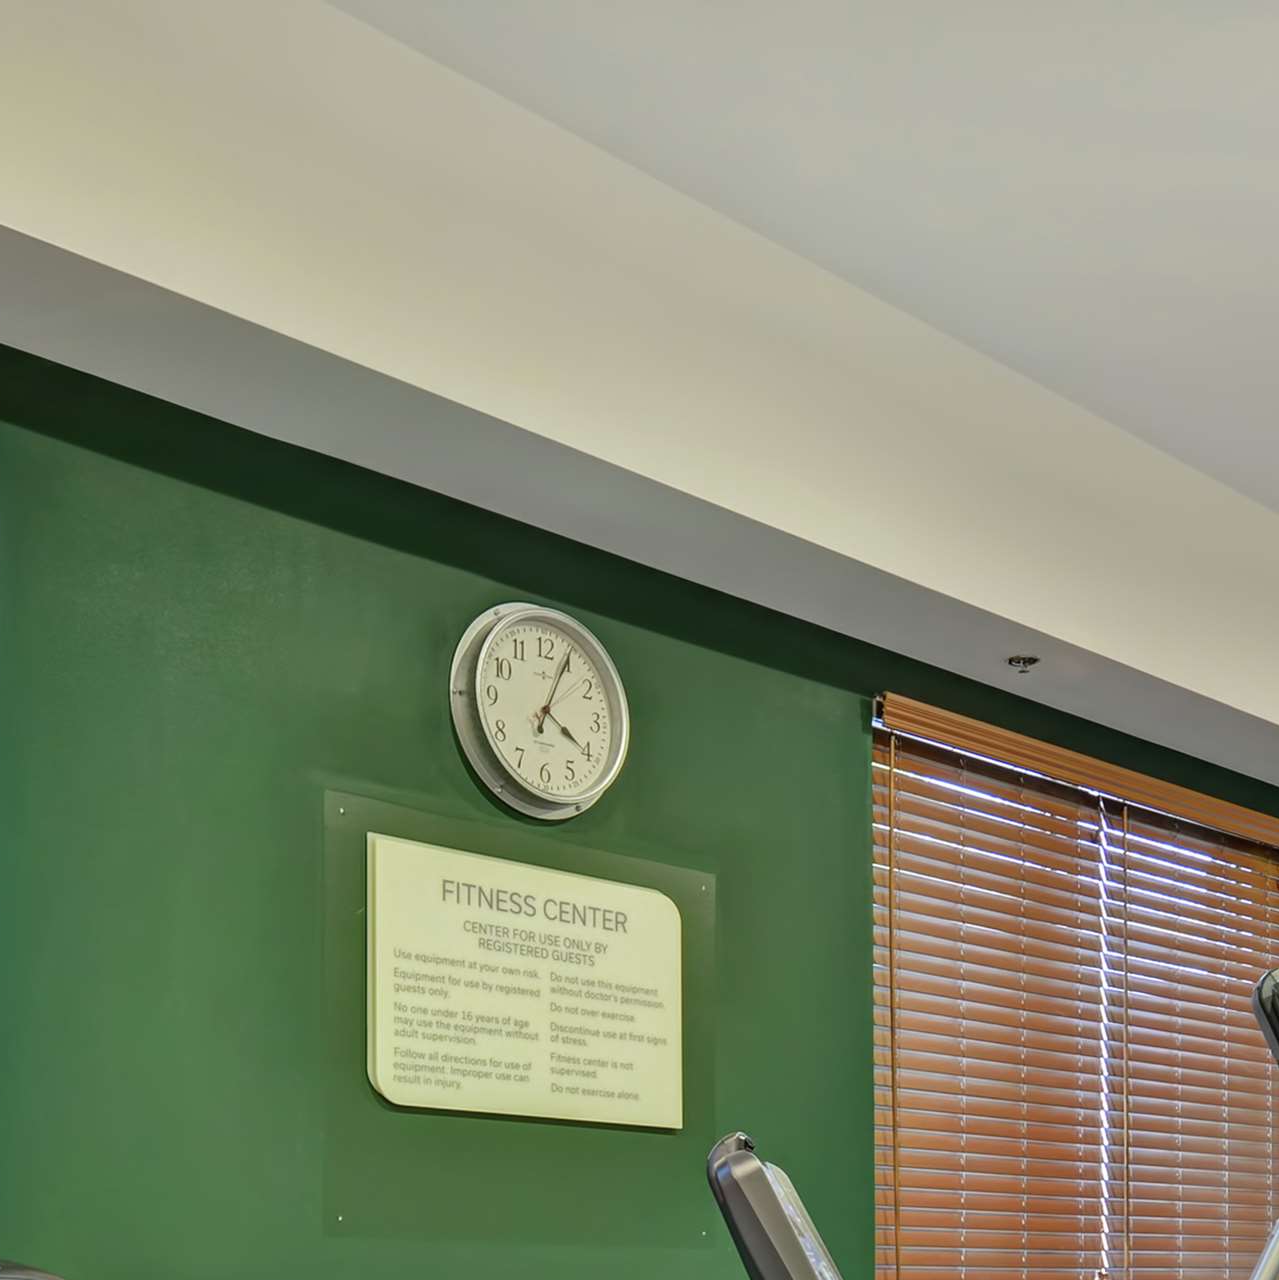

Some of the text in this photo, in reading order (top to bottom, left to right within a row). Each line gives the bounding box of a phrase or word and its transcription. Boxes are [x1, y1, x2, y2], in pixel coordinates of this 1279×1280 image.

[513, 639, 527, 661] 11
[537, 637, 554, 660] 12
[495, 657, 512, 680] 10
[487, 685, 498, 705] 9
[582, 679, 592, 700] 2
[495, 720, 506, 741] 8
[590, 712, 600, 733] 3
[515, 747, 525, 768] 7
[582, 741, 593, 762] 4
[540, 762, 551, 783] 6
[565, 760, 575, 781] 5
[442, 879, 628, 933] FITNESS CENTER
[463, 921, 608, 954] CENTER FOR USE ONLY BY
[393, 948, 412, 960] Use
[415, 952, 465, 967] equipment
[479, 963, 499, 973] your
[502, 967, 520, 975] own
[478, 938, 595, 966] REGISTERED GUESTS
[393, 983, 425, 993] guests
[394, 968, 540, 997] Equipment for use by registered
[550, 971, 658, 996] Do not use this equipment
[394, 1002, 529, 1029] No one under 16 years of age
[550, 1002, 562, 1012] Do
[565, 1006, 578, 1015] not
[581, 1007, 600, 1016] over
[394, 1015, 539, 1040] may use the equipment without
[394, 1028, 419, 1038] adult
[394, 1047, 532, 1070] Follow all directions for use of
[393, 1074, 420, 1085] result
[424, 1077, 432, 1085] in
[450, 1066, 493, 1080] Improper
[496, 1071, 511, 1080] use
[513, 1074, 529, 1082] can
[551, 1083, 563, 1094] Do
[565, 1086, 579, 1095] not
[581, 1088, 615, 1098] exercise
